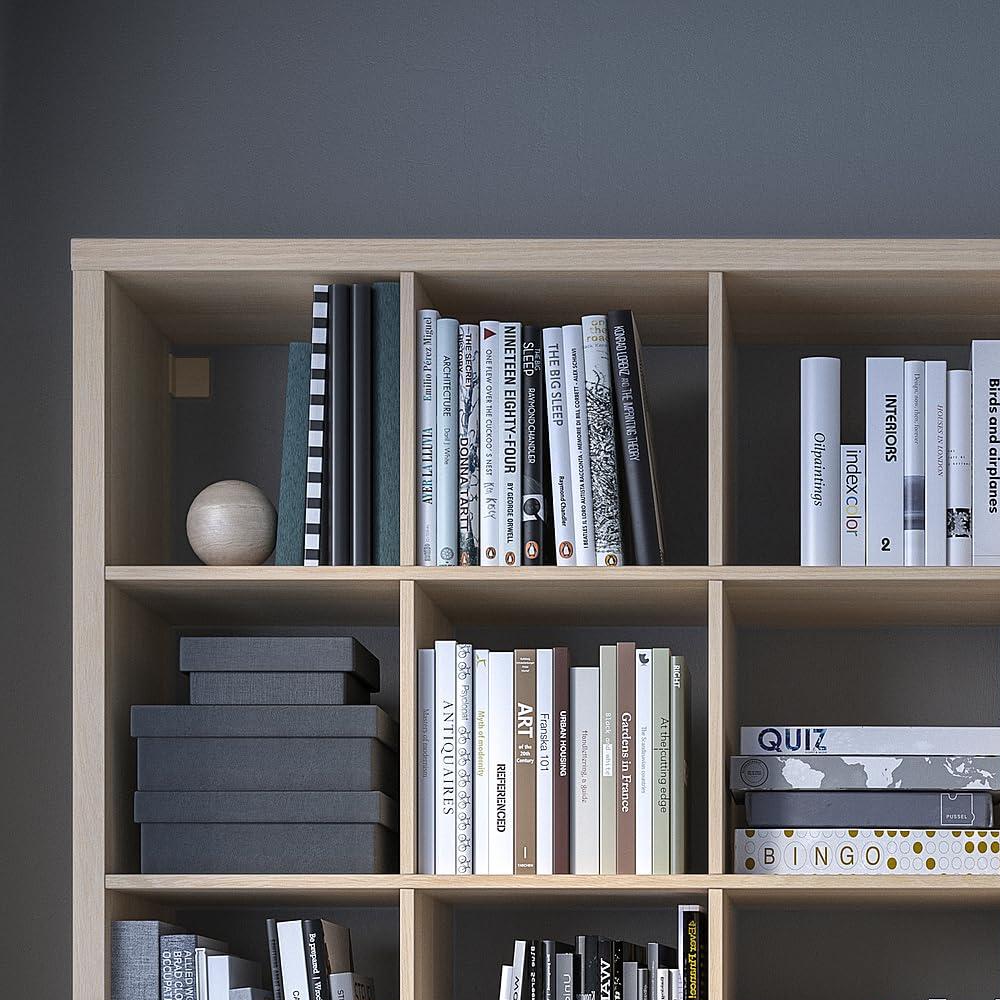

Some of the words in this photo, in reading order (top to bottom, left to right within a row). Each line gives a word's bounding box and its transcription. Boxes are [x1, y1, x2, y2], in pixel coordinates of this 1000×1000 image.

[422, 317, 434, 344] Miguel
[614, 326, 625, 350] KONRAD
[504, 326, 516, 385] NINETEEN
[523, 342, 534, 377] SLEEP
[549, 344, 559, 366] THE
[617, 352, 630, 376] LORENZ
[423, 374, 432, 401] Emilio
[443, 355, 451, 417] ARCHITECTURE
[550, 370, 561, 389] BIG
[989, 379, 1000, 413] Birds
[528, 388, 536, 424] RAYMOND
[551, 392, 563, 426] SLEEP
[422, 428, 432, 462] LLUVIA
[504, 390, 516, 473] EIGHTY-FOUR
[528, 424, 536, 464] CHANDLER
[886, 395, 897, 462] INTERIORS
[989, 417, 1000, 443] and
[460, 438, 469, 485] DONNA
[627, 437, 640, 461] THEORY
[507, 483, 513, 491] BY
[811, 433, 826, 507] Oilpaintings
[847, 451, 862, 495] index
[986, 448, 1000, 513] airplanes
[422, 480, 432, 504] AYER
[460, 489, 469, 531] TARTT
[847, 497, 862, 536] color
[882, 538, 891, 552] 2
[477, 711, 485, 729] Myth
[518, 702, 534, 739] ART
[540, 714, 549, 751] Franska
[622, 713, 631, 758] Gardens
[660, 718, 669, 729] At
[660, 732, 670, 747] the
[758, 728, 828, 752] QUIZ
[441, 701, 454, 815] ANTIQUAIRES
[477, 740, 485, 777] modernity
[540, 755, 549, 771] 101
[622, 761, 631, 772] in
[658, 751, 669, 784] cutting
[497, 764, 506, 832] REFERENCED
[622, 774, 631, 813] France
[658, 788, 669, 813] edge
[174, 951, 183, 979] BRAD
[184, 951, 192, 984] ALLIED
